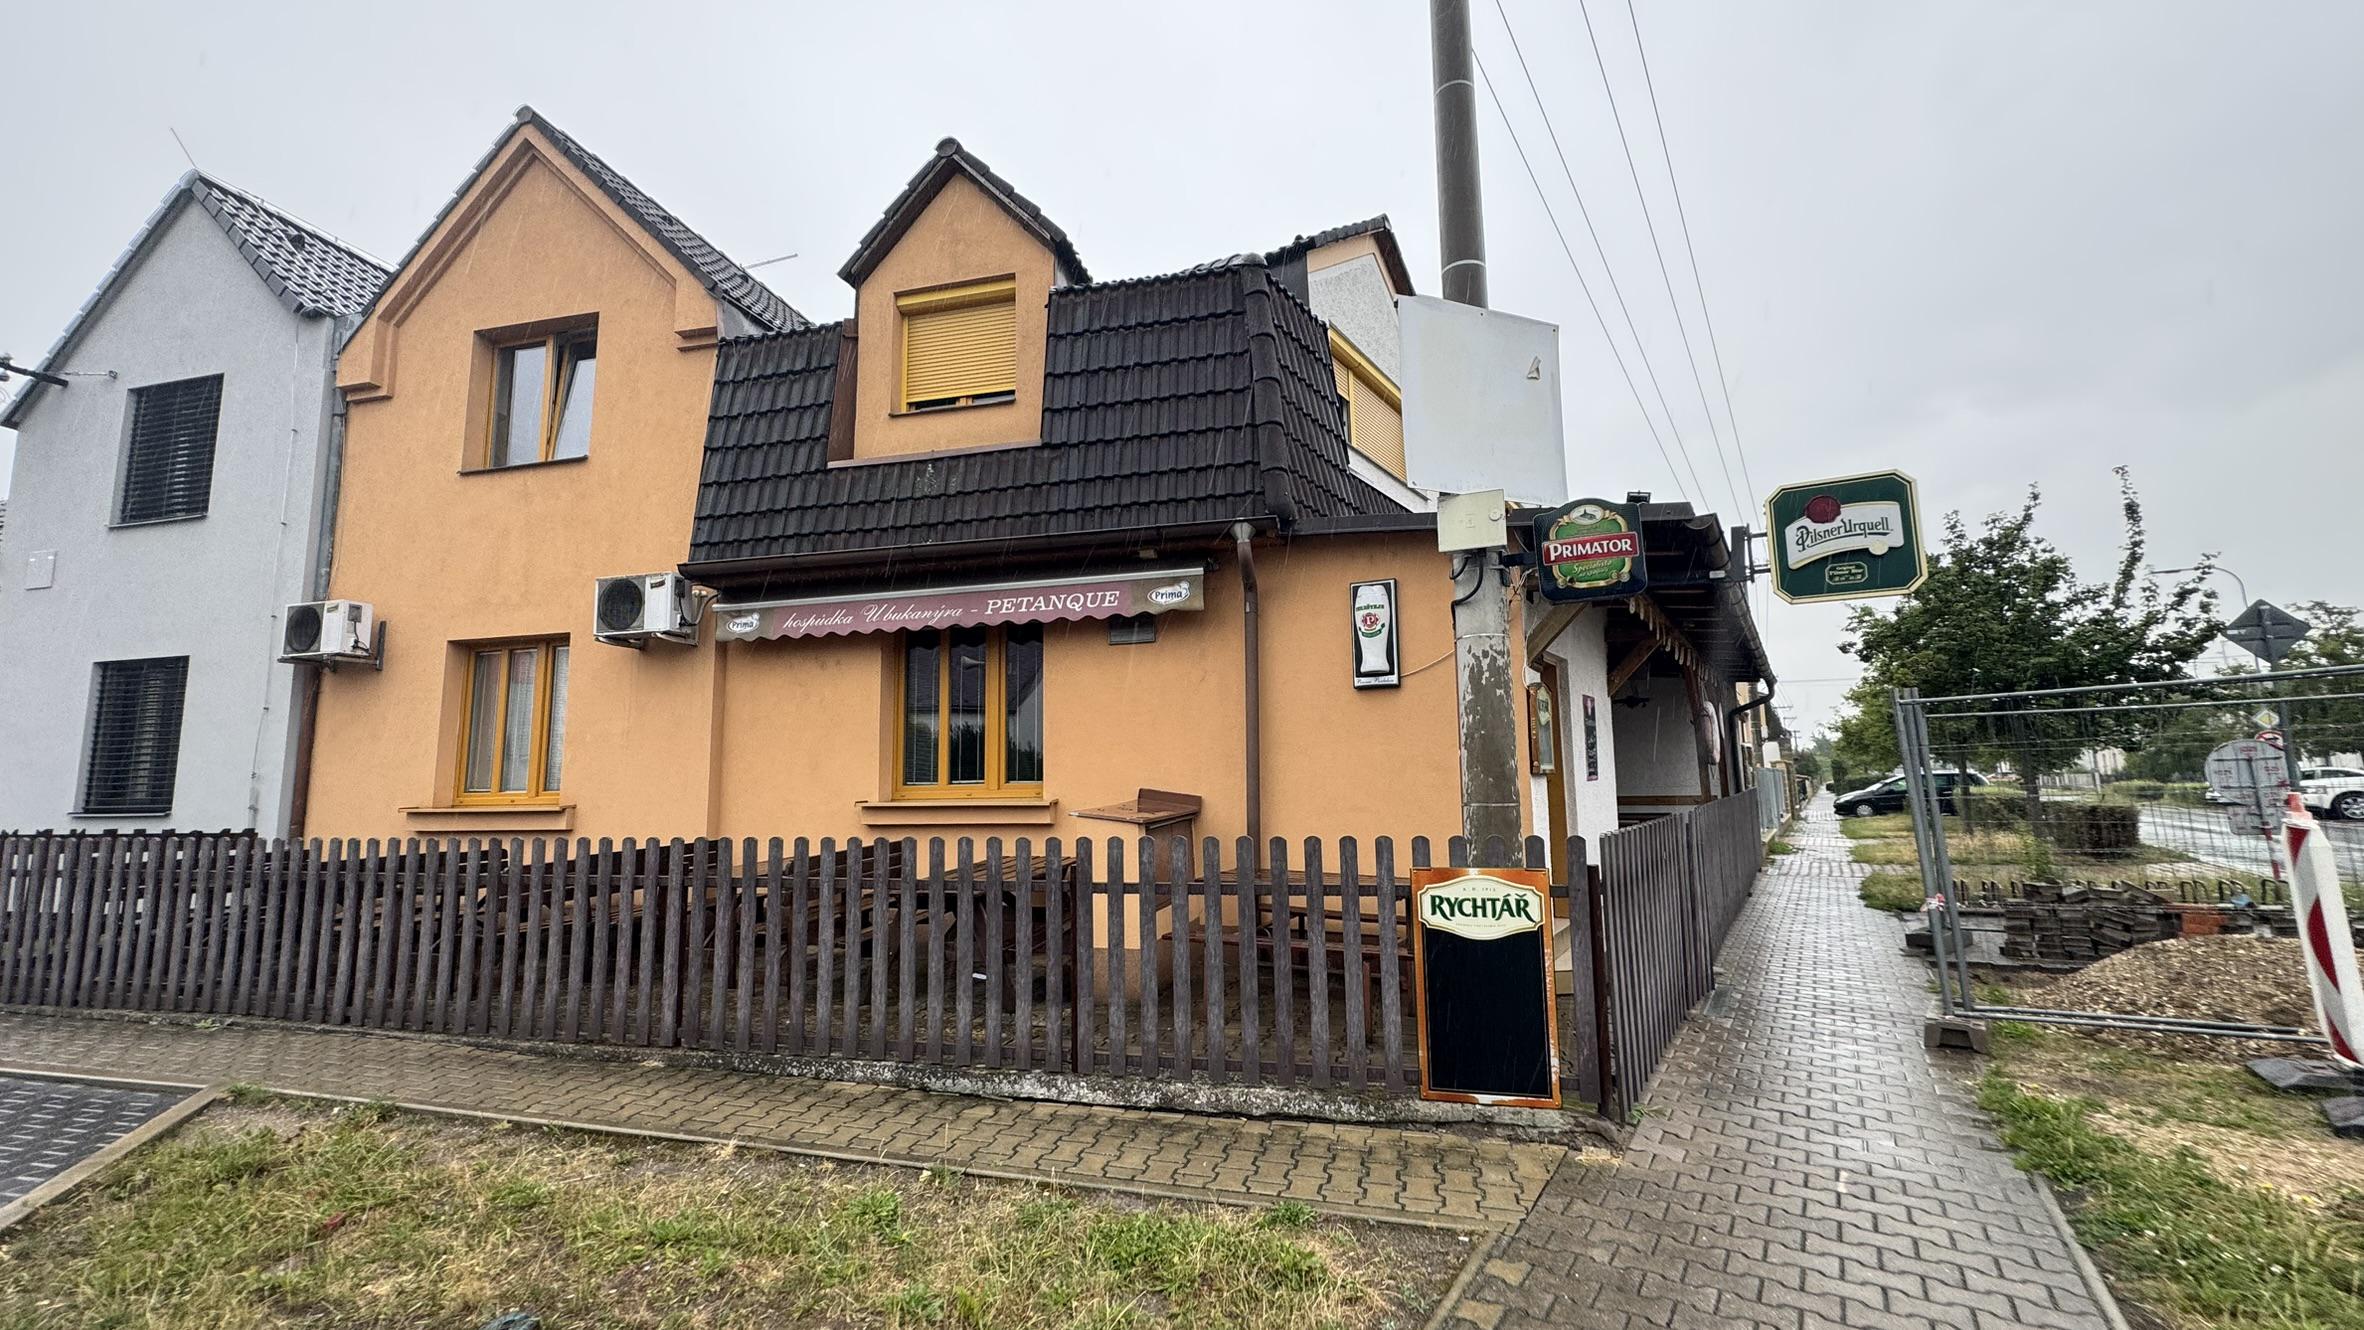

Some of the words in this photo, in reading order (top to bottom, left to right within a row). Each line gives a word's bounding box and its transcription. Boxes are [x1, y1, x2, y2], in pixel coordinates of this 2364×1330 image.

[1796, 525, 1842, 553] Pilsner
[1841, 516, 1889, 538] Urquell
[1549, 538, 1633, 562] PRIMATOR
[860, 603, 888, 623] U
[883, 603, 963, 625] bukanýra
[984, 591, 1120, 614] PETANQUE
[1155, 590, 1183, 600] Prima
[732, 620, 754, 629] Prima
[1430, 893, 1536, 923] RYCHTÁŘ
